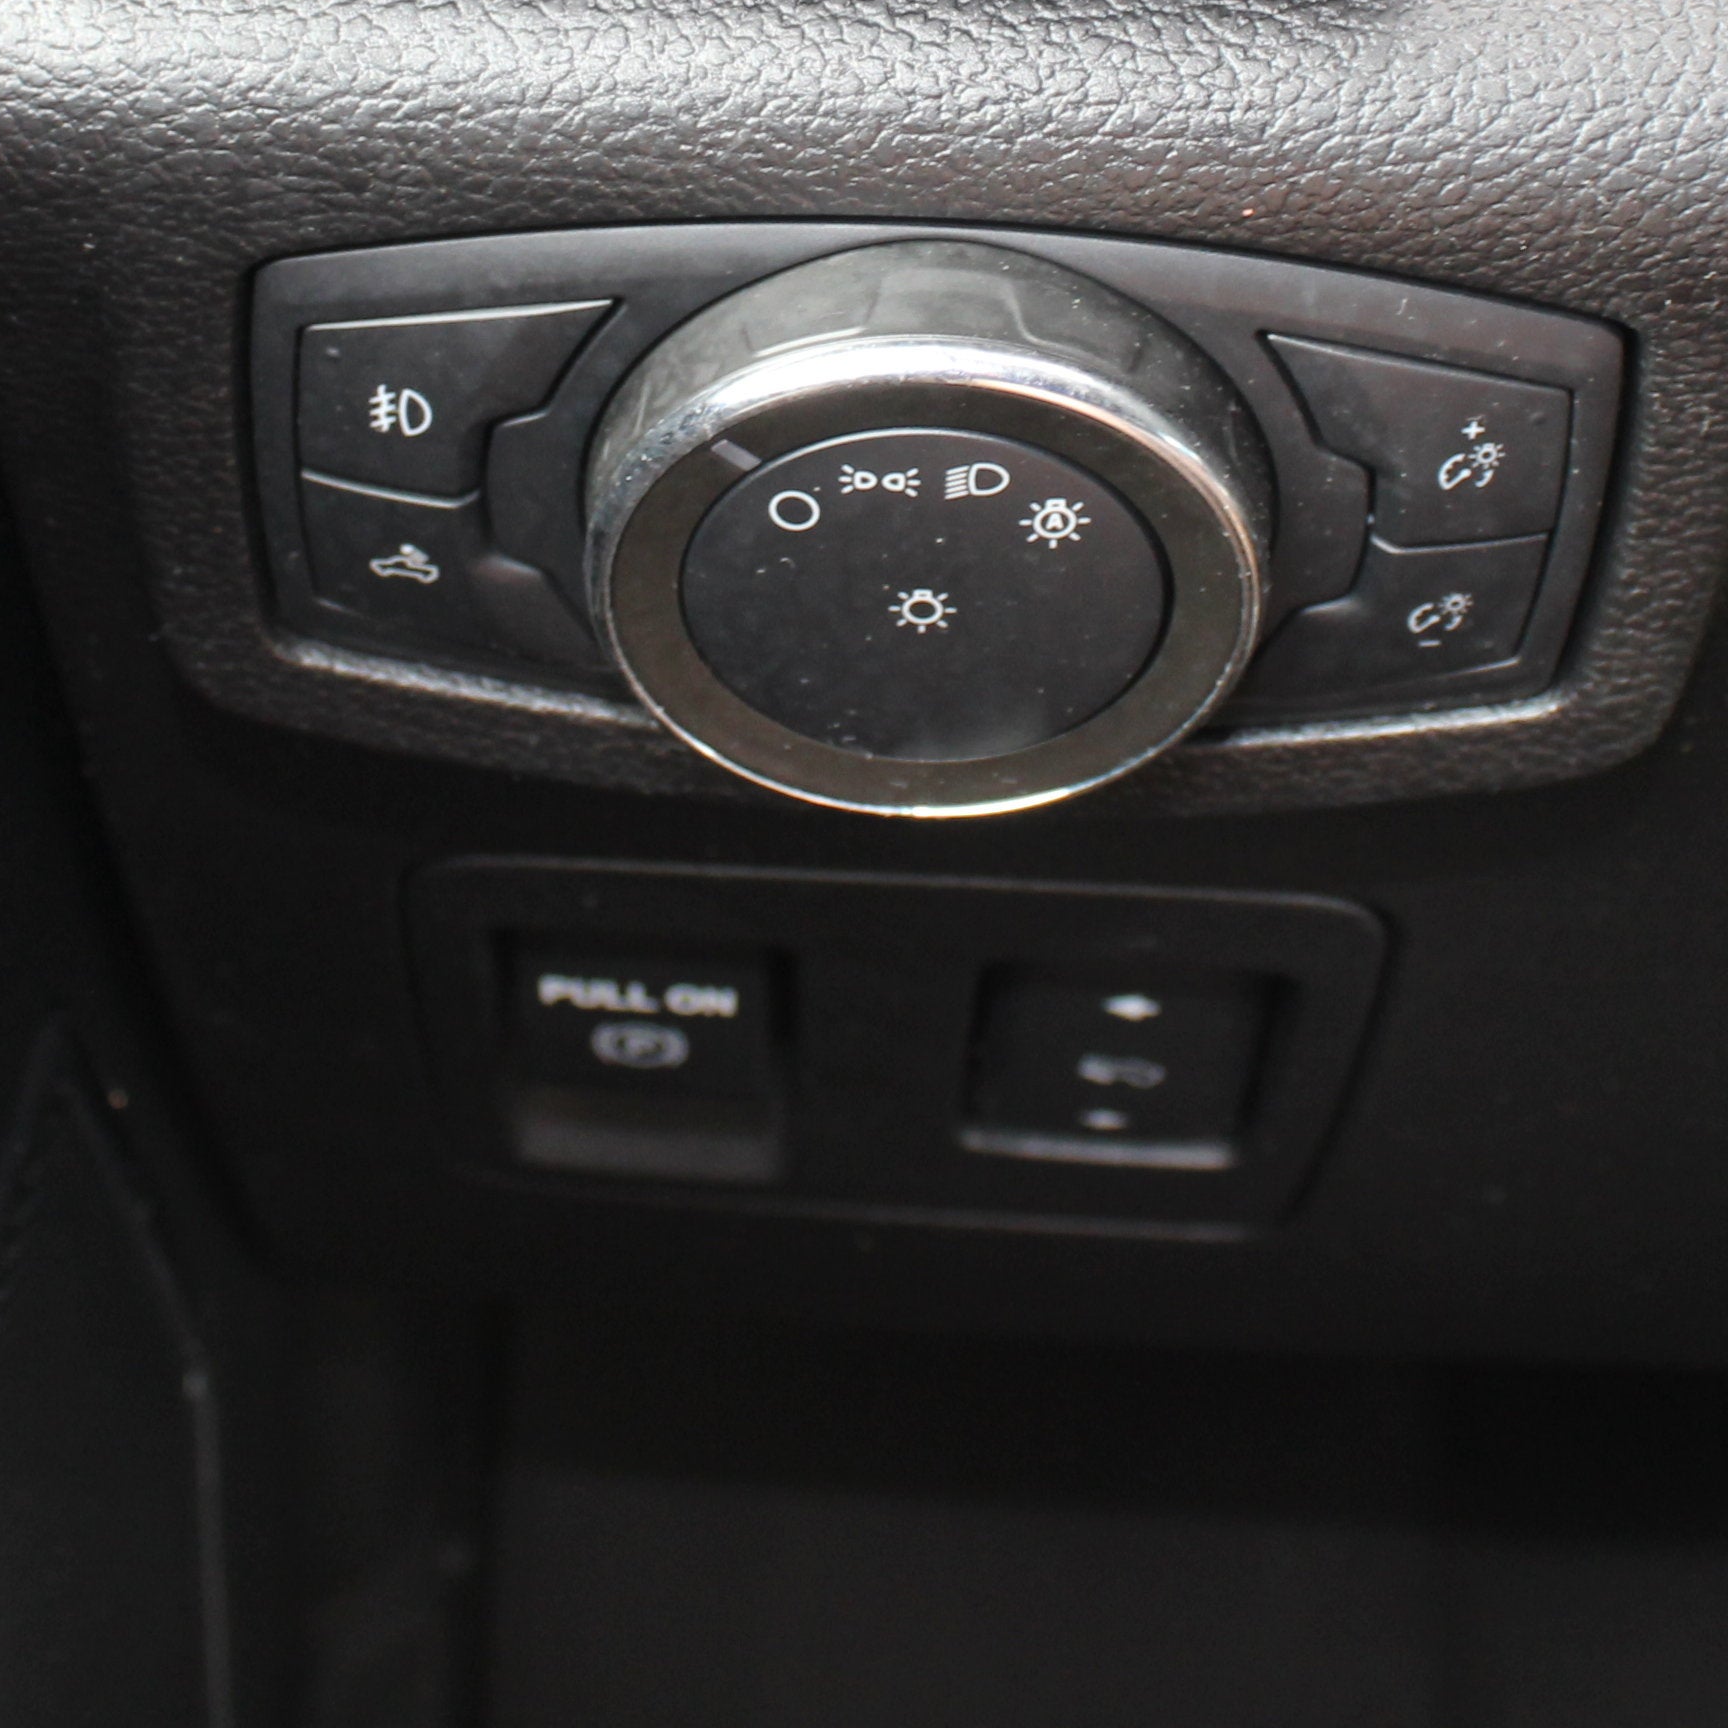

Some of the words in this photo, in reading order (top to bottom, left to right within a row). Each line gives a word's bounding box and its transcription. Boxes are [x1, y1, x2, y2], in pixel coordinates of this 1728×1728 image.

[1045, 512, 1065, 531] A
[537, 973, 660, 1014] PULL
[663, 982, 739, 1018] ON
